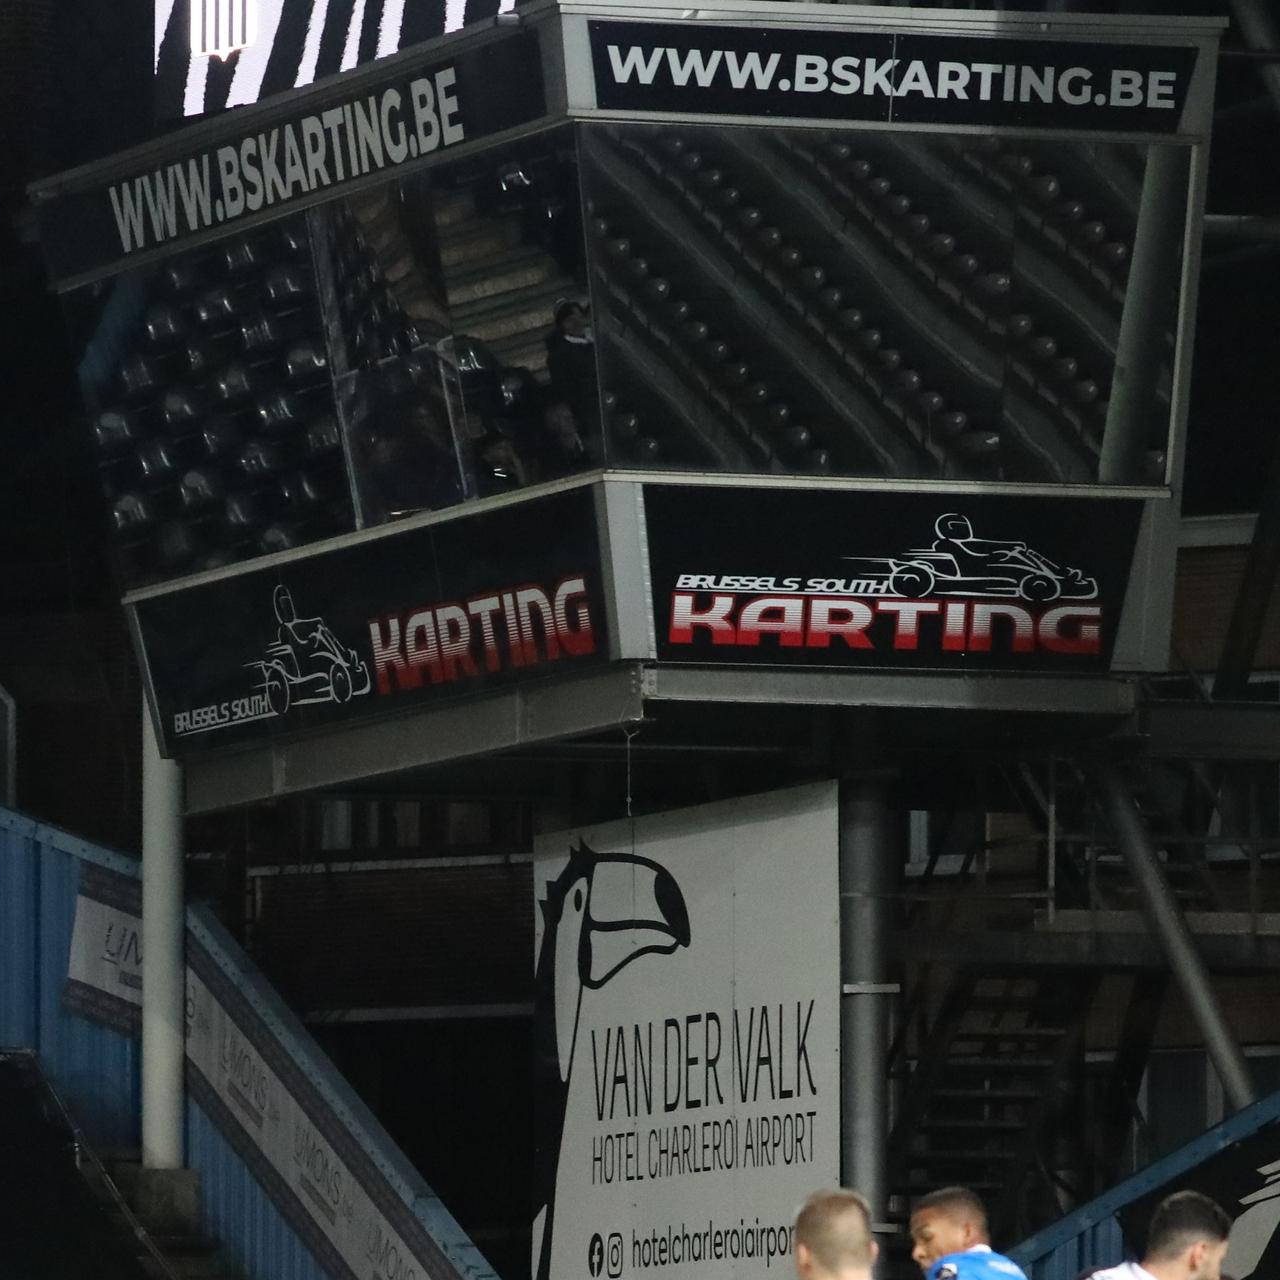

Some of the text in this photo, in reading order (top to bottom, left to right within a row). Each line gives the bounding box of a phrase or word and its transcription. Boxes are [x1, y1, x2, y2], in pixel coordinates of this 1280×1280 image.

[607, 45, 1177, 109] WWW.BSKARTING.BE
[109, 66, 466, 253] WWW.BSKARTING.BE
[675, 574, 889, 595] BRUSSELS SOUTH
[368, 577, 596, 695] KARTING
[668, 593, 1105, 655] KARTING
[174, 701, 231, 735] BRUSSELS
[591, 999, 817, 1122] VAN DER VALK
[592, 1111, 817, 1185] HOTEL CHARLEROI AIRPORT
[631, 1217, 798, 1269] hotelcharleroiairpor
